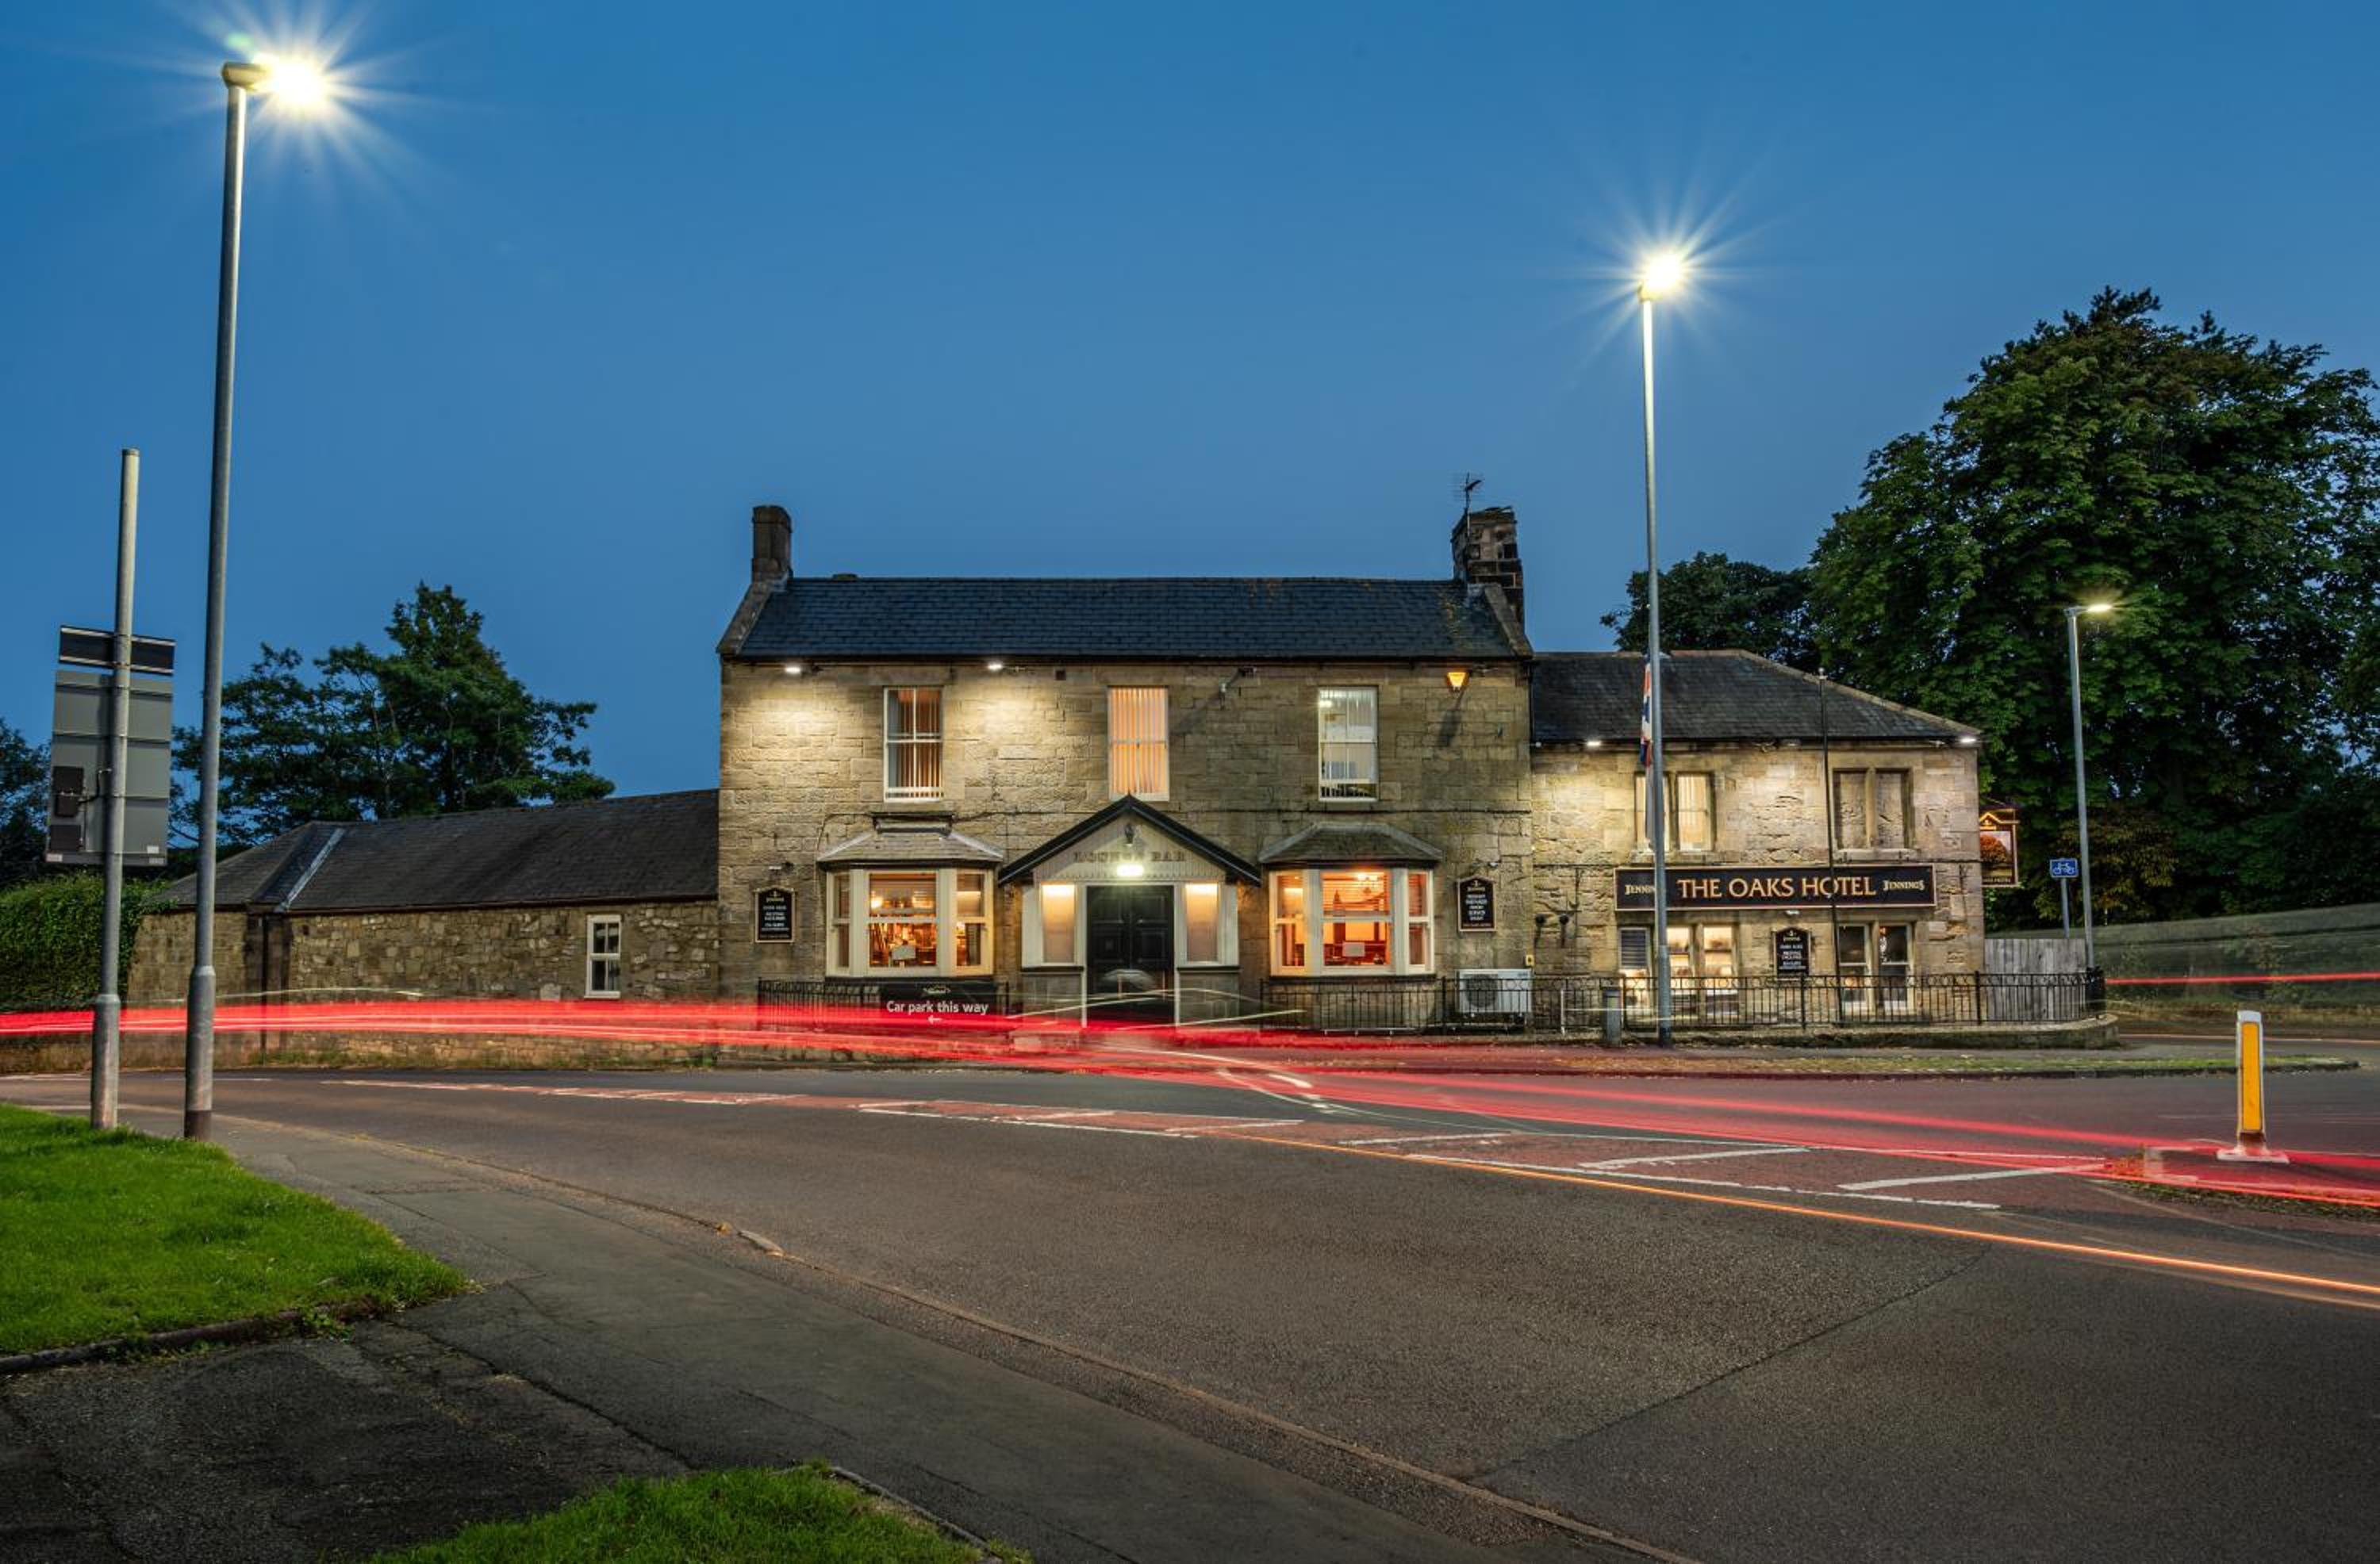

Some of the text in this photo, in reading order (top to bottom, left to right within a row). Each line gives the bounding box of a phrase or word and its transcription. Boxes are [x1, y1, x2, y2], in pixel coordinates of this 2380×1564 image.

[1151, 851, 1187, 862] BAR
[1625, 876, 1925, 899] JENNIN THE OAKS HOTEL JENNINGS
[886, 1000, 989, 1016] Car park this way
